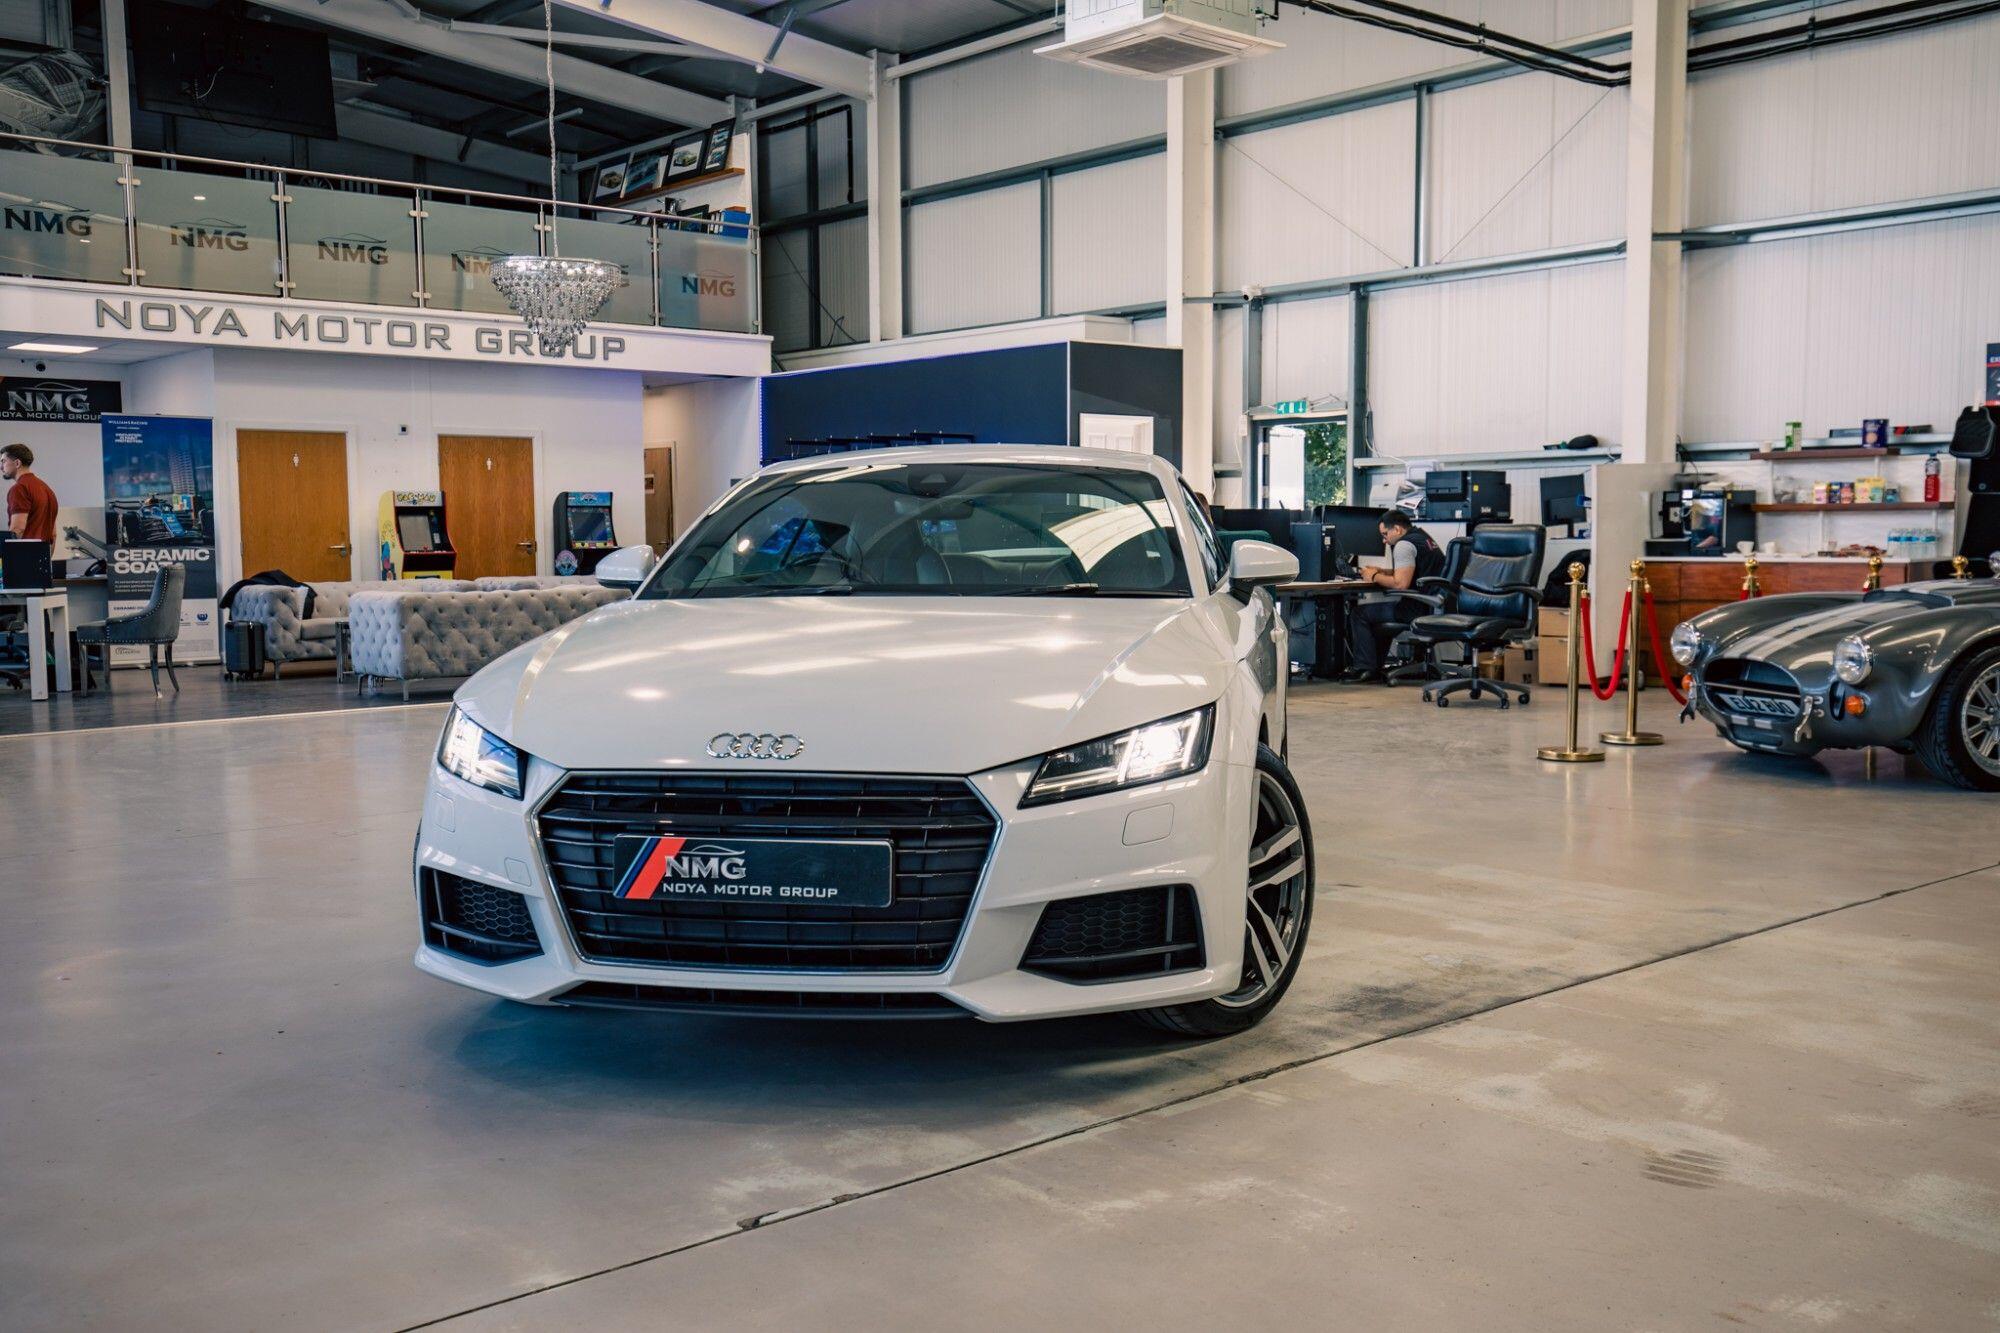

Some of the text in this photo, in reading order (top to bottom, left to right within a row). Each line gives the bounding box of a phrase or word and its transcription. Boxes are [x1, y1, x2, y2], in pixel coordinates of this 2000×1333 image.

[5, 207, 92, 237] NMG
[171, 225, 249, 251] NMG
[317, 240, 389, 266] NMG
[682, 276, 736, 298] NMG
[96, 299, 248, 338] NOYA
[274, 312, 451, 351] MOTOR
[8, 390, 90, 413] NMG
[0, 411, 23, 419] OYA
[27, 412, 65, 420] MOTOR
[113, 548, 210, 562] CERAMIC
[664, 855, 747, 880] NMG
[662, 883, 838, 898] NOYA MOTOR GROUP
